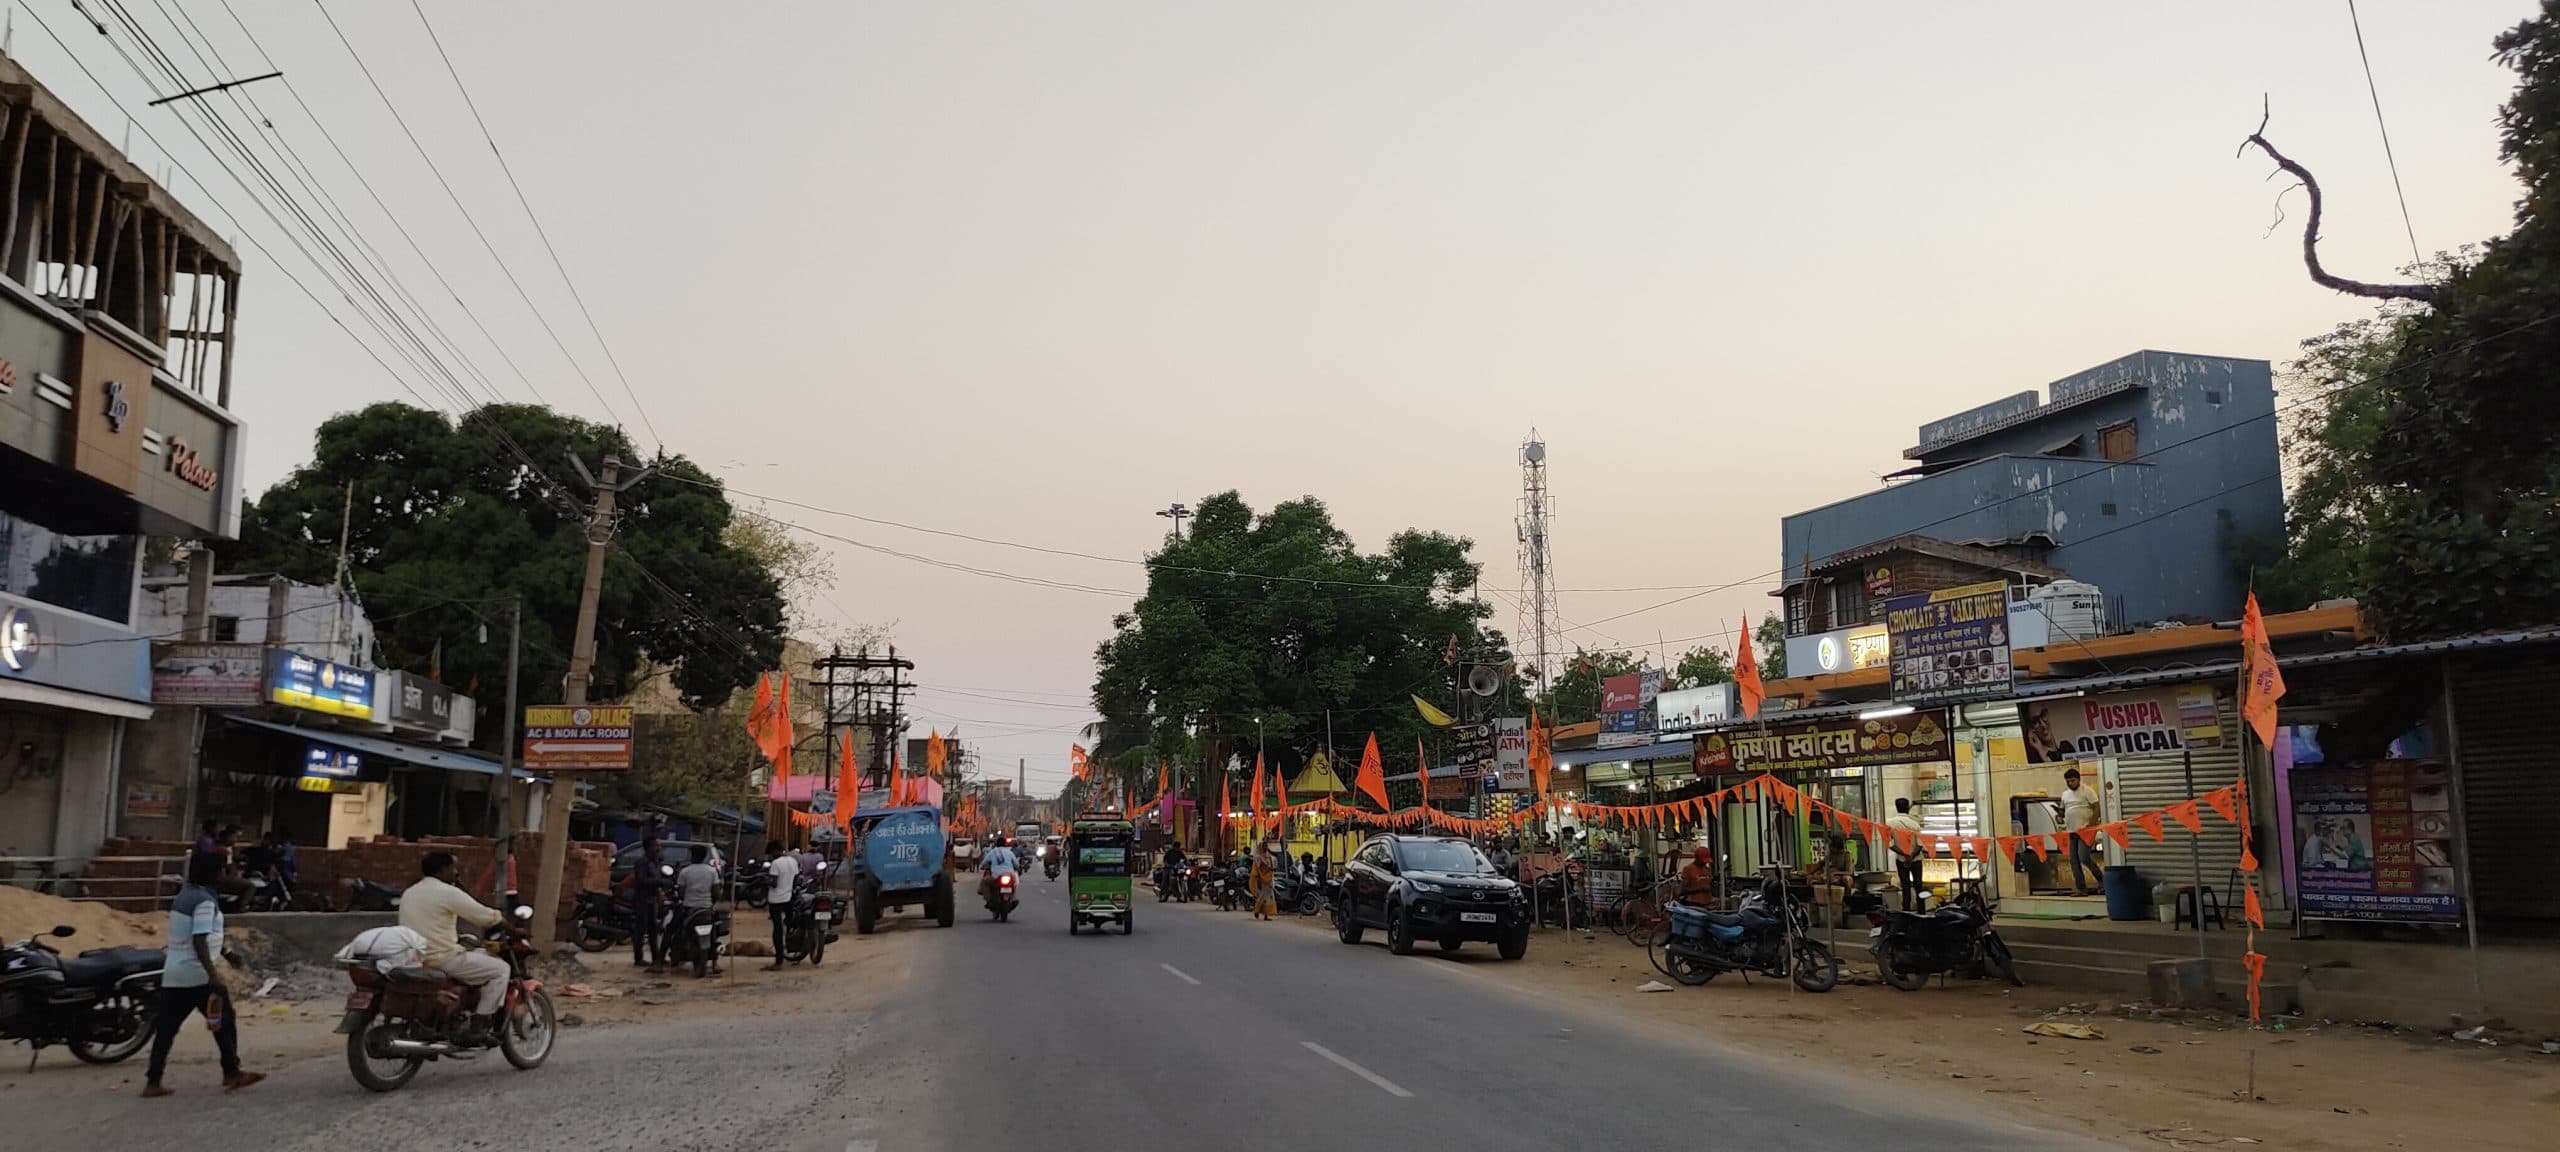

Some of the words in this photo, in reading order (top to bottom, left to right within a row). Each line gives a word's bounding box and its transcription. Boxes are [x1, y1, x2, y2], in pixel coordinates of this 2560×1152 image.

[170, 434, 217, 491] Palace
[1888, 606, 1935, 634] CHOCOLATE
[1950, 599, 1974, 623] CAKE
[1975, 593, 2005, 619] HOUSE
[433, 695, 448, 718] OLA
[591, 709, 632, 726] PALACE
[2084, 701, 2164, 731] PUSHPA
[528, 728, 542, 738] AC
[545, 729, 552, 738] &
[555, 728, 578, 738] NON
[581, 729, 595, 738] AC
[596, 728, 629, 738] ROOM
[1500, 738, 1525, 750] ATM
[2078, 729, 2184, 754] OPTICAL
[1699, 752, 1726, 766] Krishna
